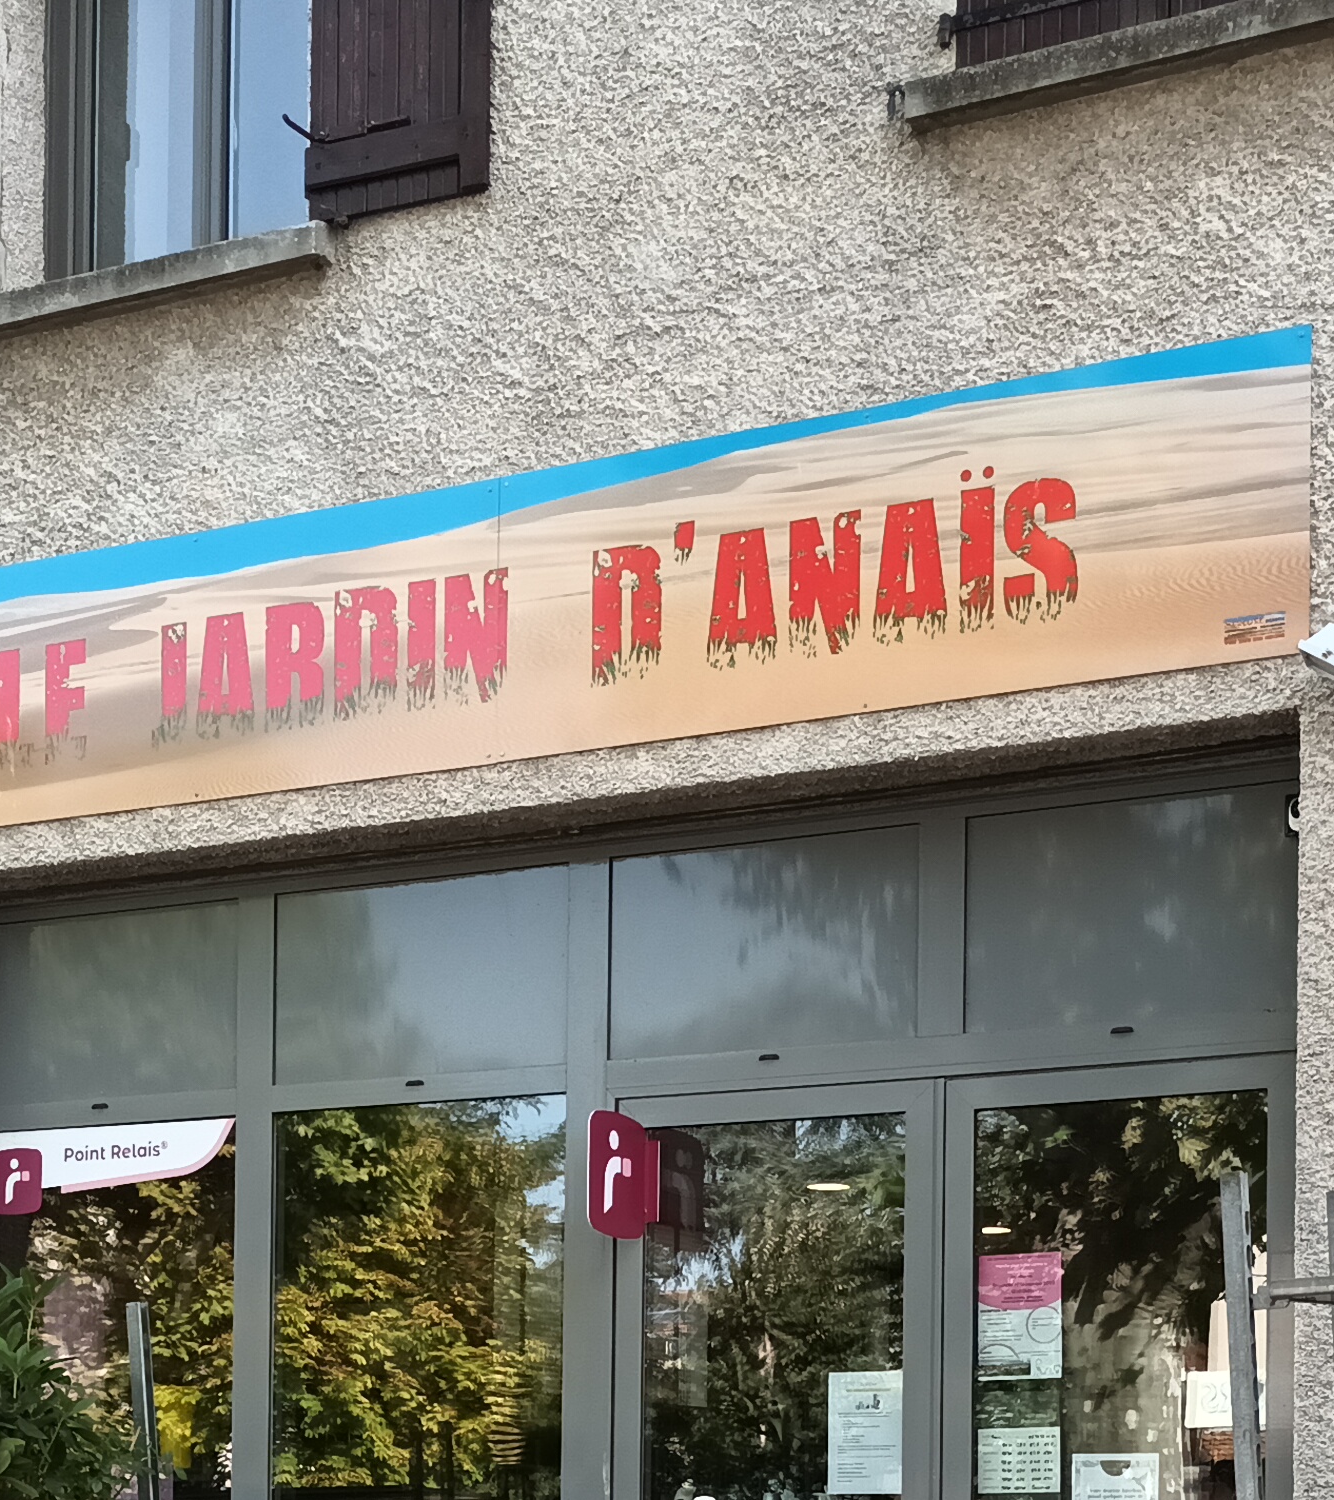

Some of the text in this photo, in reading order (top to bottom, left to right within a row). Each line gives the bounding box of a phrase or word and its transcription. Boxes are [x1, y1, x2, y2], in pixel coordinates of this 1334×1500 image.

[152, 567, 509, 750] JARDIN
[590, 465, 1079, 690] D'ANAÏS
[64, 1144, 106, 1162] Point
